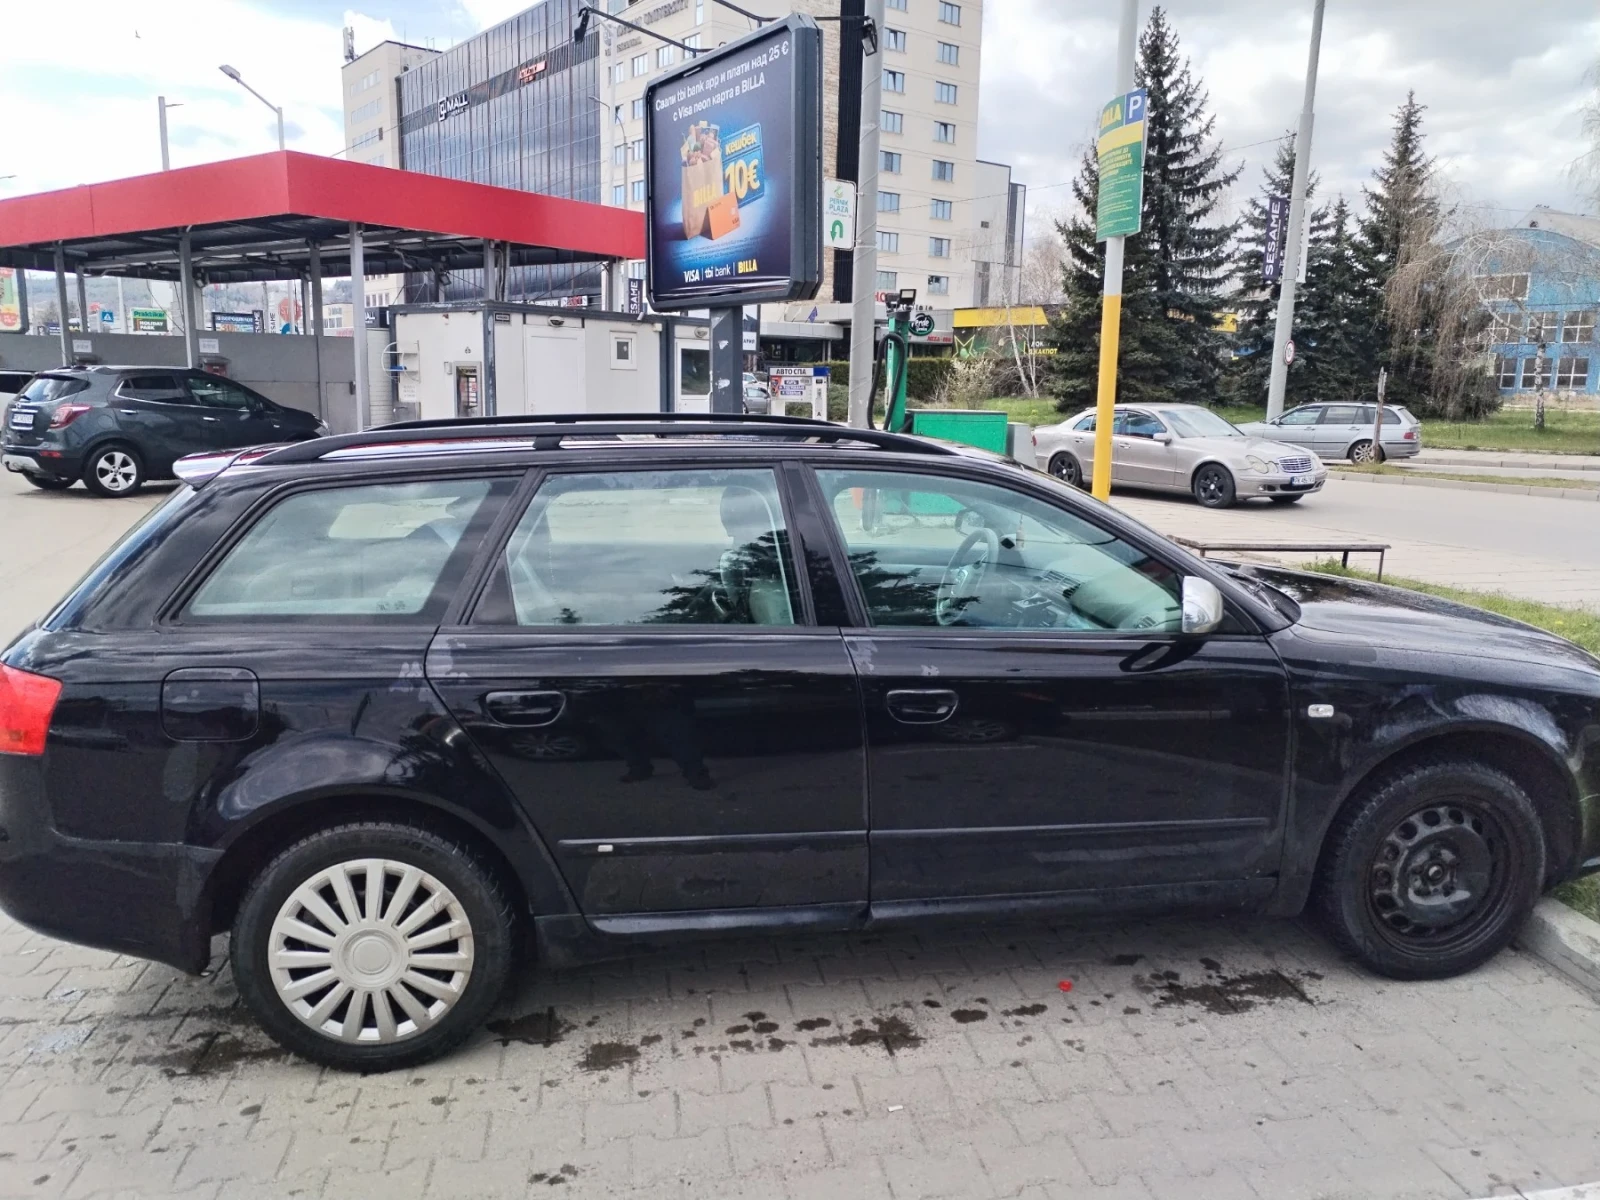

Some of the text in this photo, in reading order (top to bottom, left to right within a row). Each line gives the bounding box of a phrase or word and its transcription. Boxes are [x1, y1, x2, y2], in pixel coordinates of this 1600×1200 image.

[655, 41, 789, 111] Свали tbi bank app и плати над 25 €
[678, 104, 693, 120] Visa
[693, 99, 712, 114] neon
[712, 88, 734, 106] карта
[735, 86, 741, 96] в
[741, 72, 765, 93] BILLA
[1128, 95, 1142, 119] P
[725, 131, 757, 156] кешбек
[724, 158, 760, 199] 10€
[829, 197, 849, 206] PERNIK
[829, 204, 849, 213] PLAZA
[1265, 201, 1281, 276] SESAME
[683, 259, 757, 283] VISA tbi bank BILLA
[133, 310, 165, 318] Praktiker
